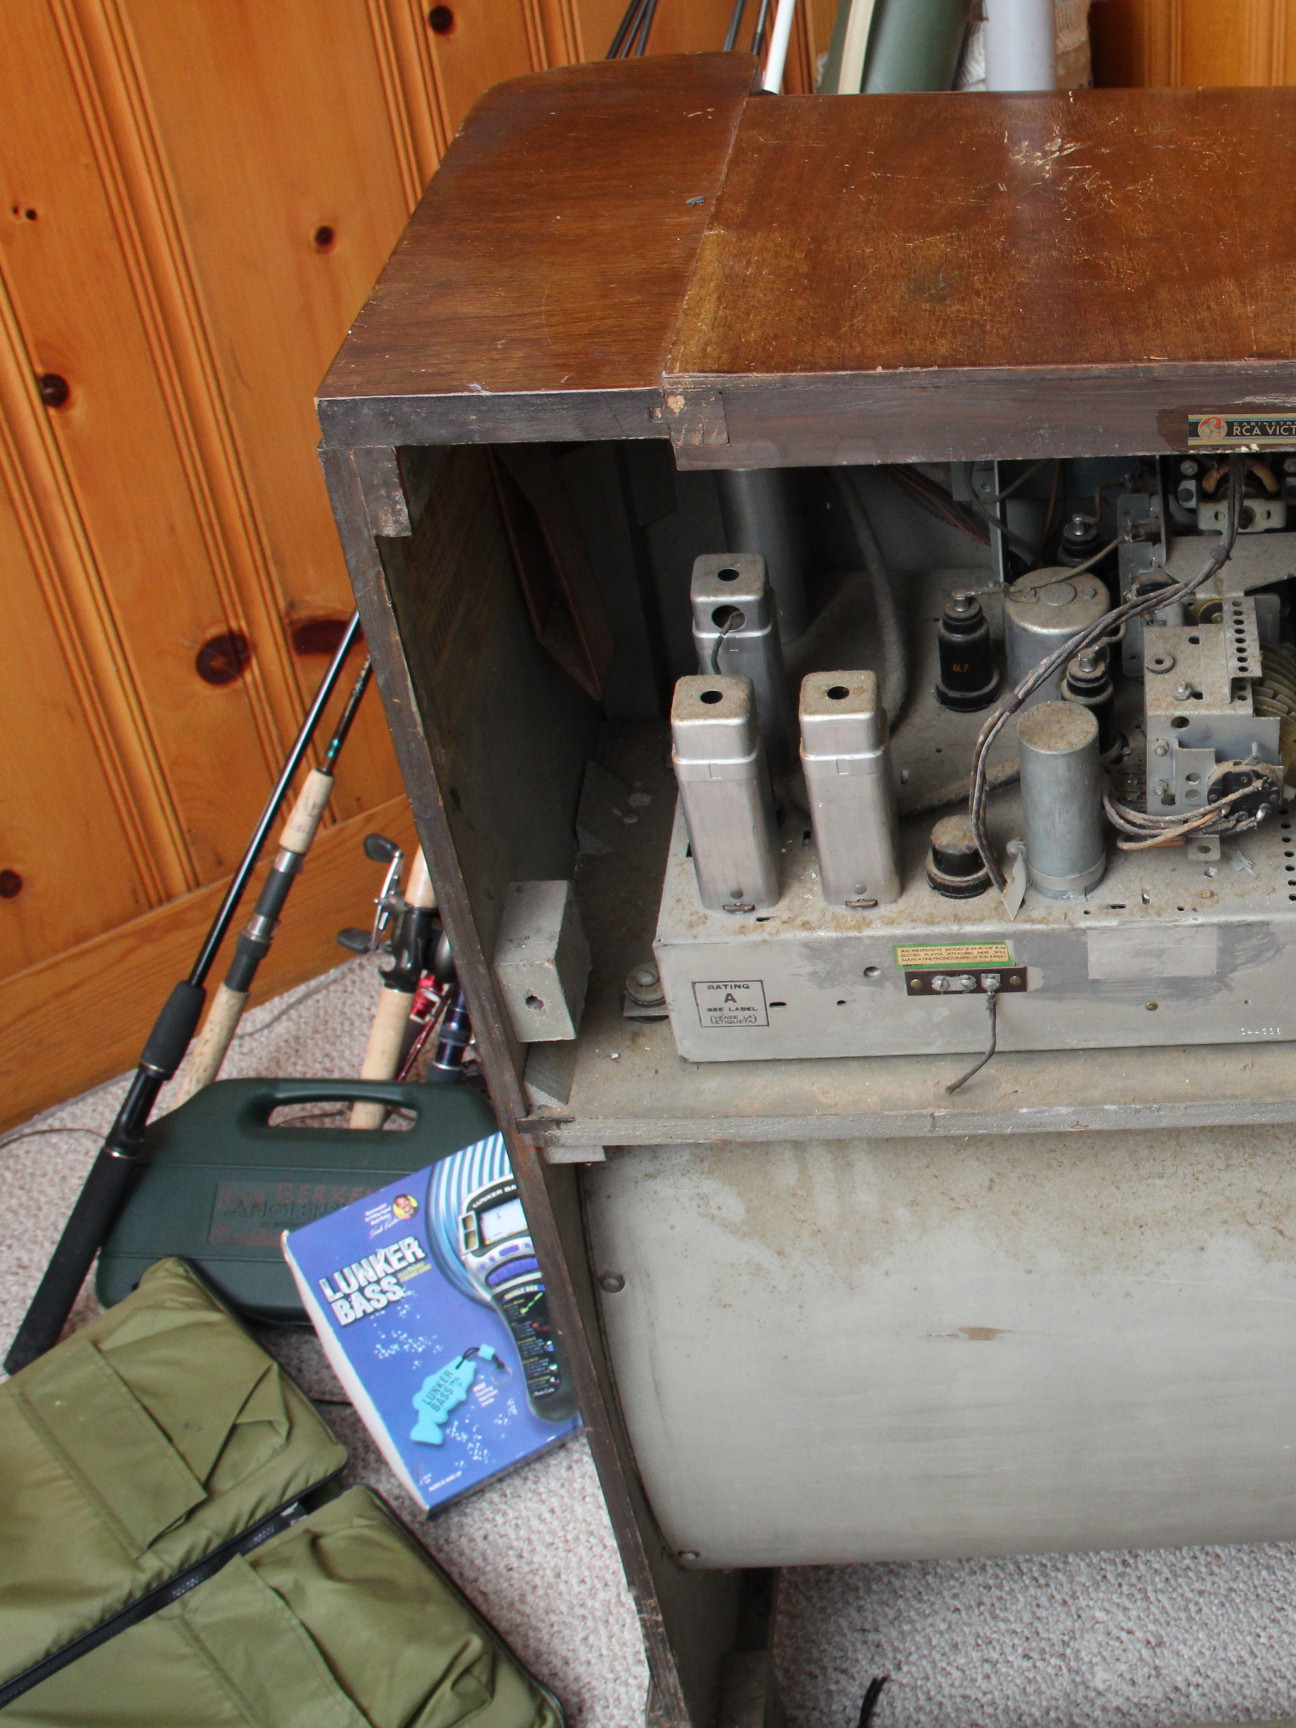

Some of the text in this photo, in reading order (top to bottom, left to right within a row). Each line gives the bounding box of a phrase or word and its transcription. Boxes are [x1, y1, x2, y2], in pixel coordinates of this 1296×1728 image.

[1233, 425, 1261, 436] RCA
[724, 993, 737, 1003] A
[472, 1189, 503, 1208] LUNKER
[318, 1236, 427, 1303] LUNKER
[331, 1275, 405, 1327] BASS
[422, 1369, 454, 1405] LUNKER
[431, 1385, 455, 1412] BASS
